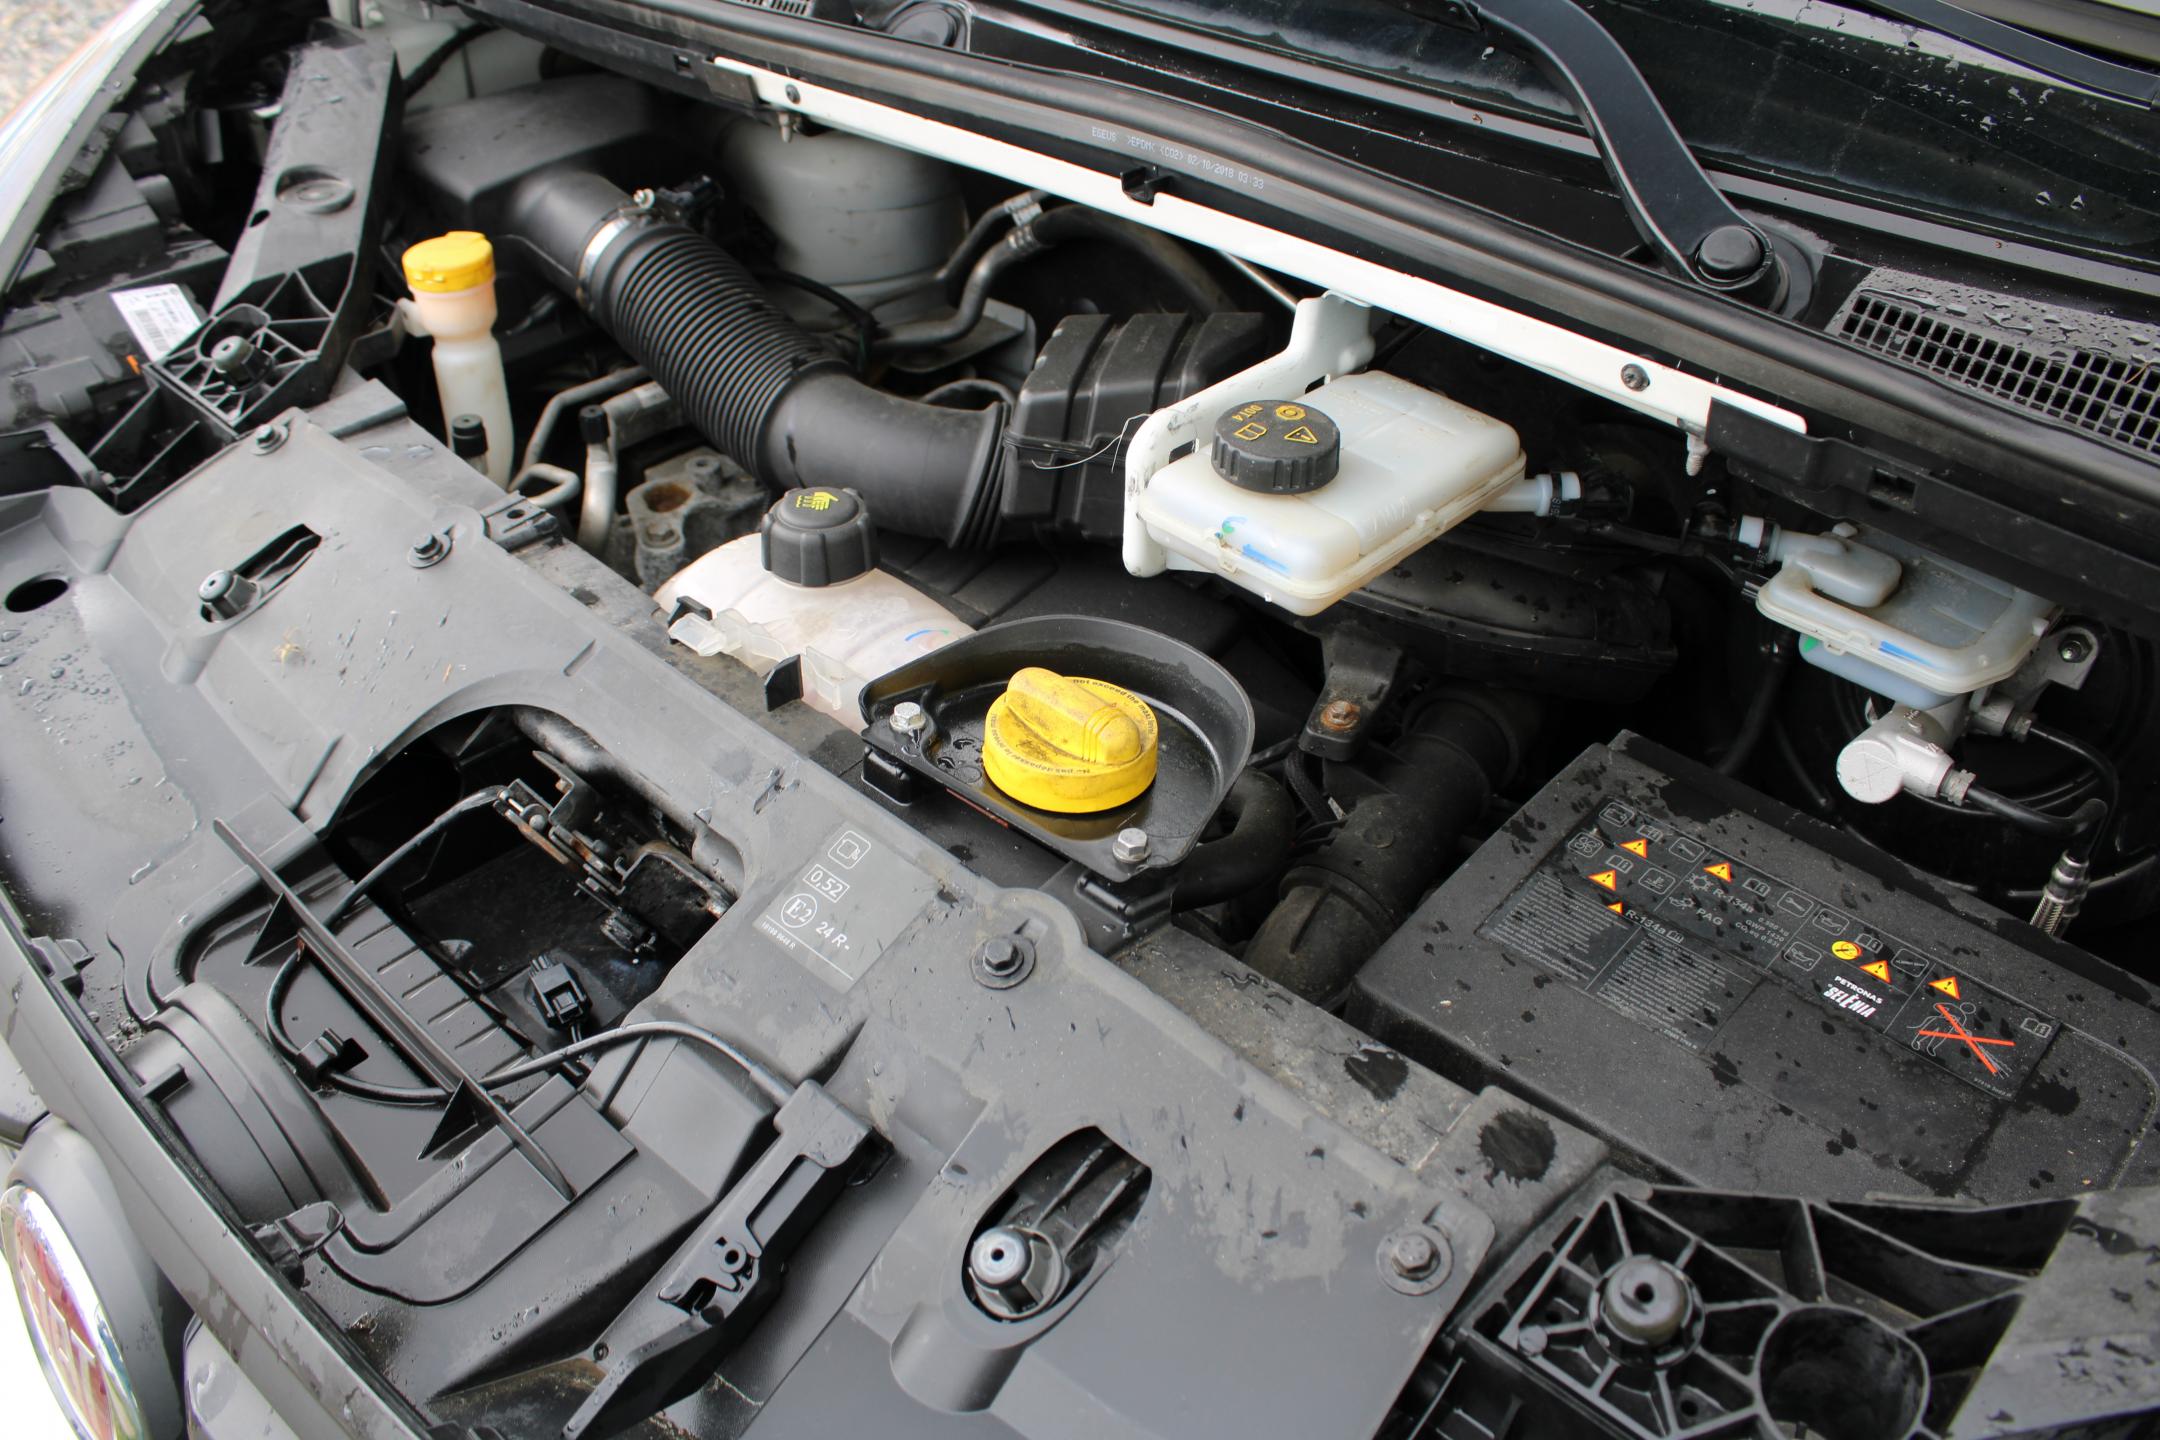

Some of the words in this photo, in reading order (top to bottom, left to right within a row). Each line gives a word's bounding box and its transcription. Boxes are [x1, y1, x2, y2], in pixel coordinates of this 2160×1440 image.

[1092, 680, 1128, 696] exceed
[1127, 693, 1140, 704] the
[810, 869, 844, 898] 0,52
[1712, 888, 1755, 914] R-134a
[1625, 909, 1667, 935] R-134a
[1695, 907, 1724, 926] PAG
[815, 921, 835, 939] 24
[1834, 975, 1884, 1004] PETRONAS
